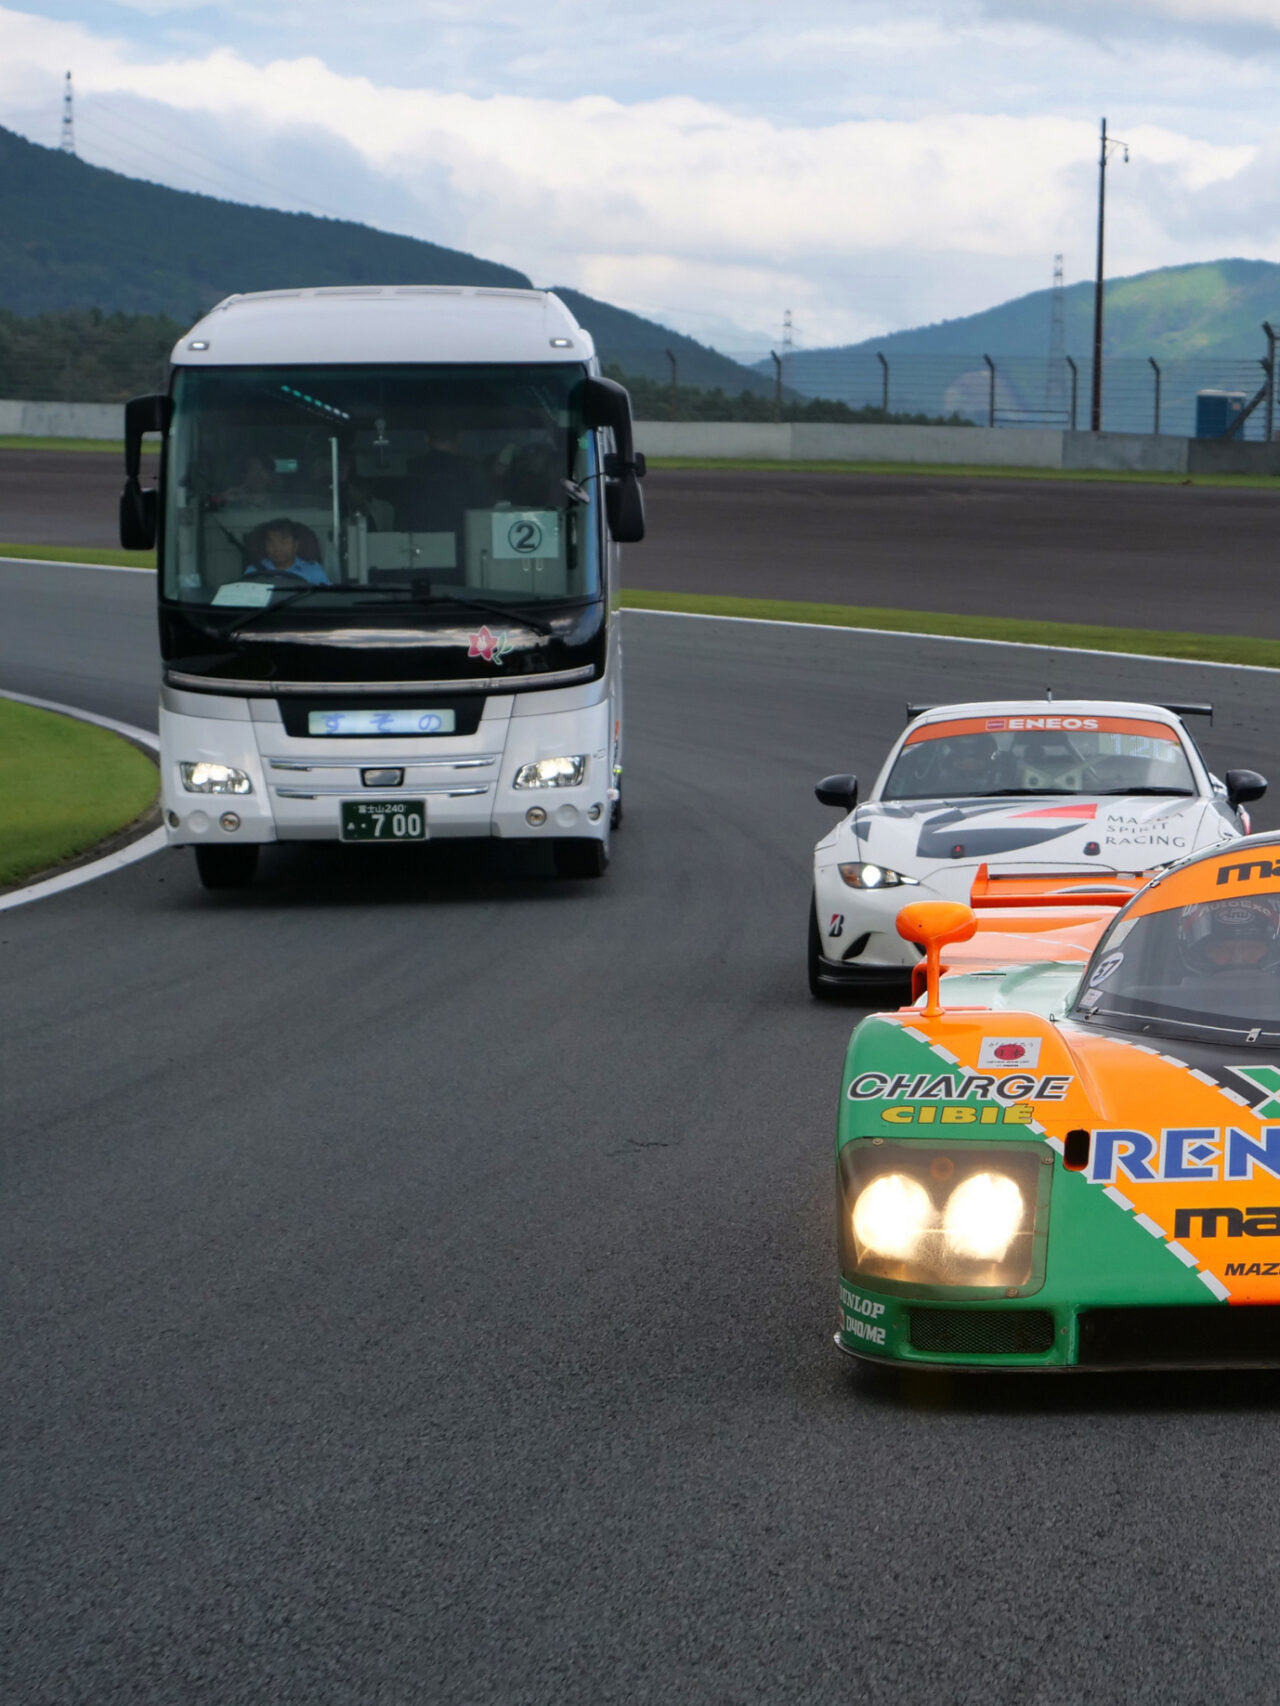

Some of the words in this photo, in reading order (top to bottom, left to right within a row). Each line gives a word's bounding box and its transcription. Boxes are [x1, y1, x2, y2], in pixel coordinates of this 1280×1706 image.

[320, 712, 443, 735] すその
[1008, 718, 1099, 729] ENEOS
[1105, 835, 1186, 848] RACING
[847, 1072, 1074, 1100] CHARGE
[880, 1103, 1035, 1124] CIBIÉ
